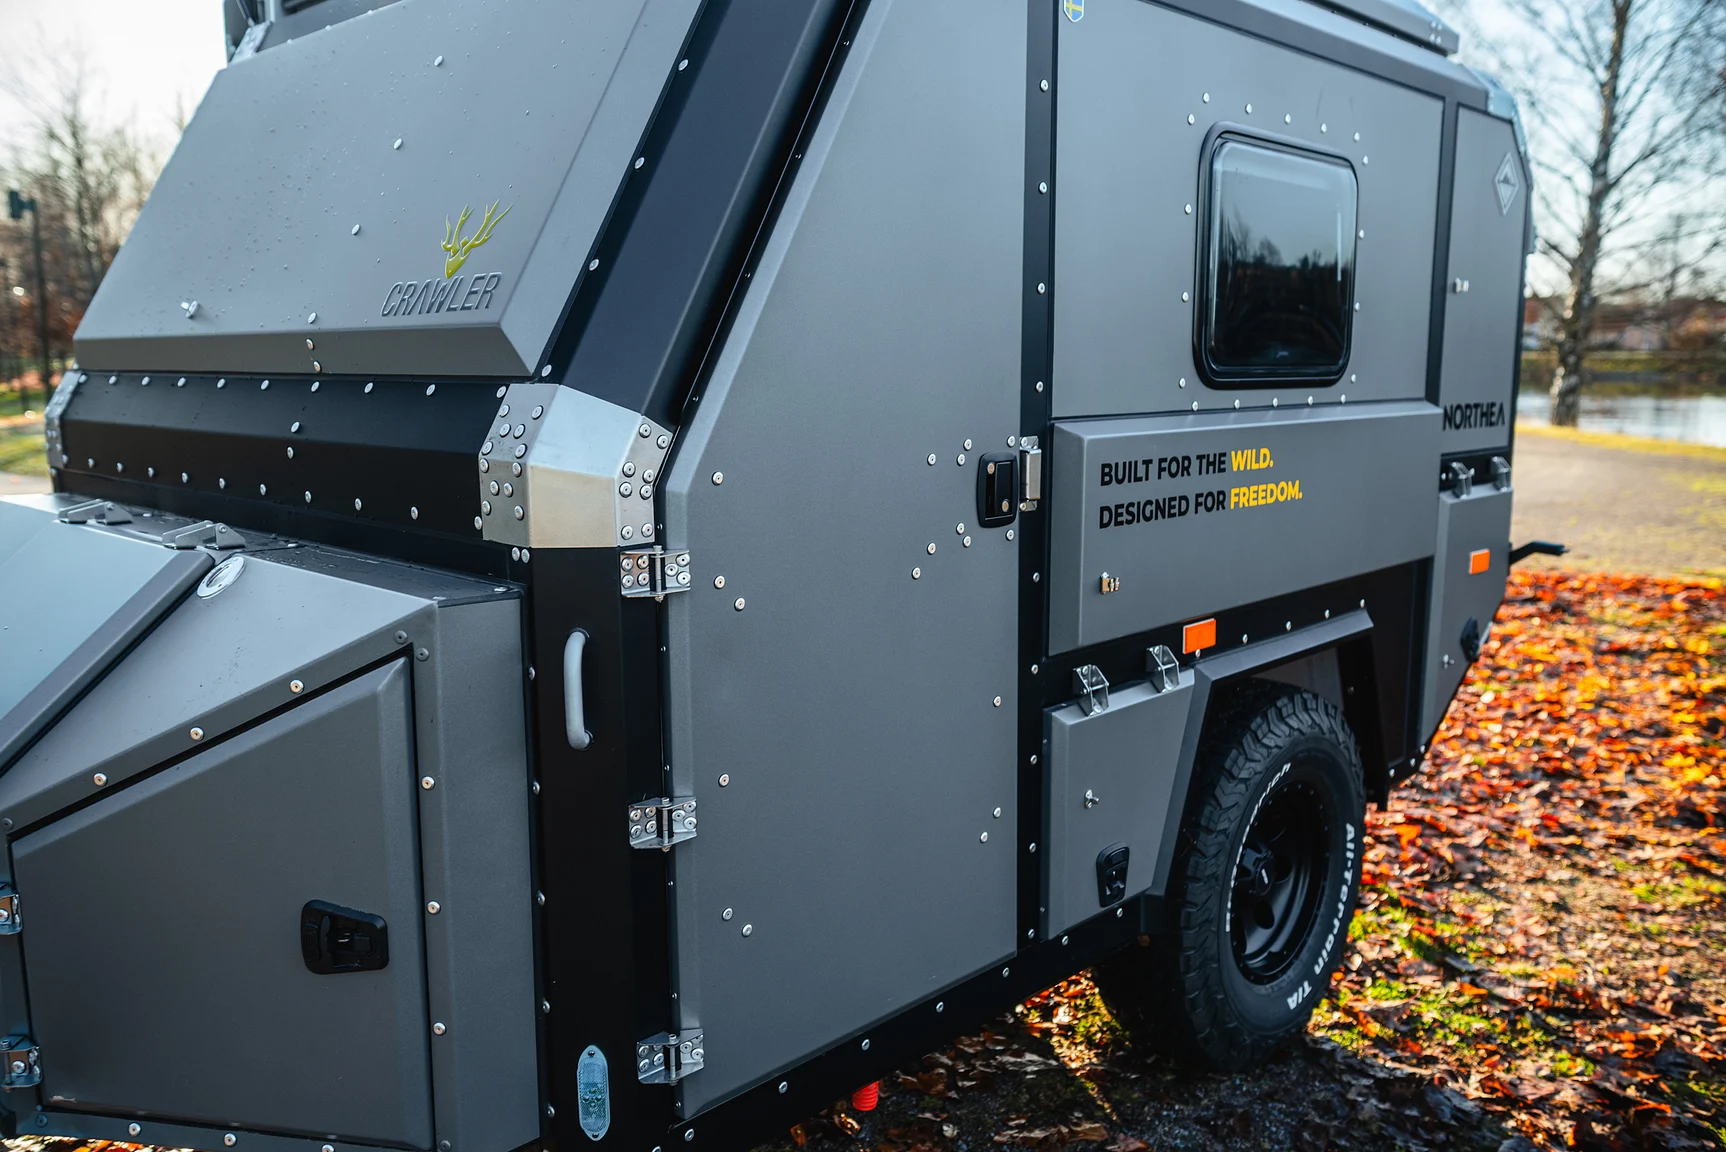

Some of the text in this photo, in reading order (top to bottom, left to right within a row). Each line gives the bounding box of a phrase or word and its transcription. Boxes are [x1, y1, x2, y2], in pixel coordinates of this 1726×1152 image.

[380, 271, 503, 317] CRAWLER
[1100, 447, 1274, 487] BUILT FOR THE WILD.
[1099, 479, 1303, 529] DESIGNED FOR FREEDOM.
[1286, 822, 1356, 1010] All-Terrain T/A
